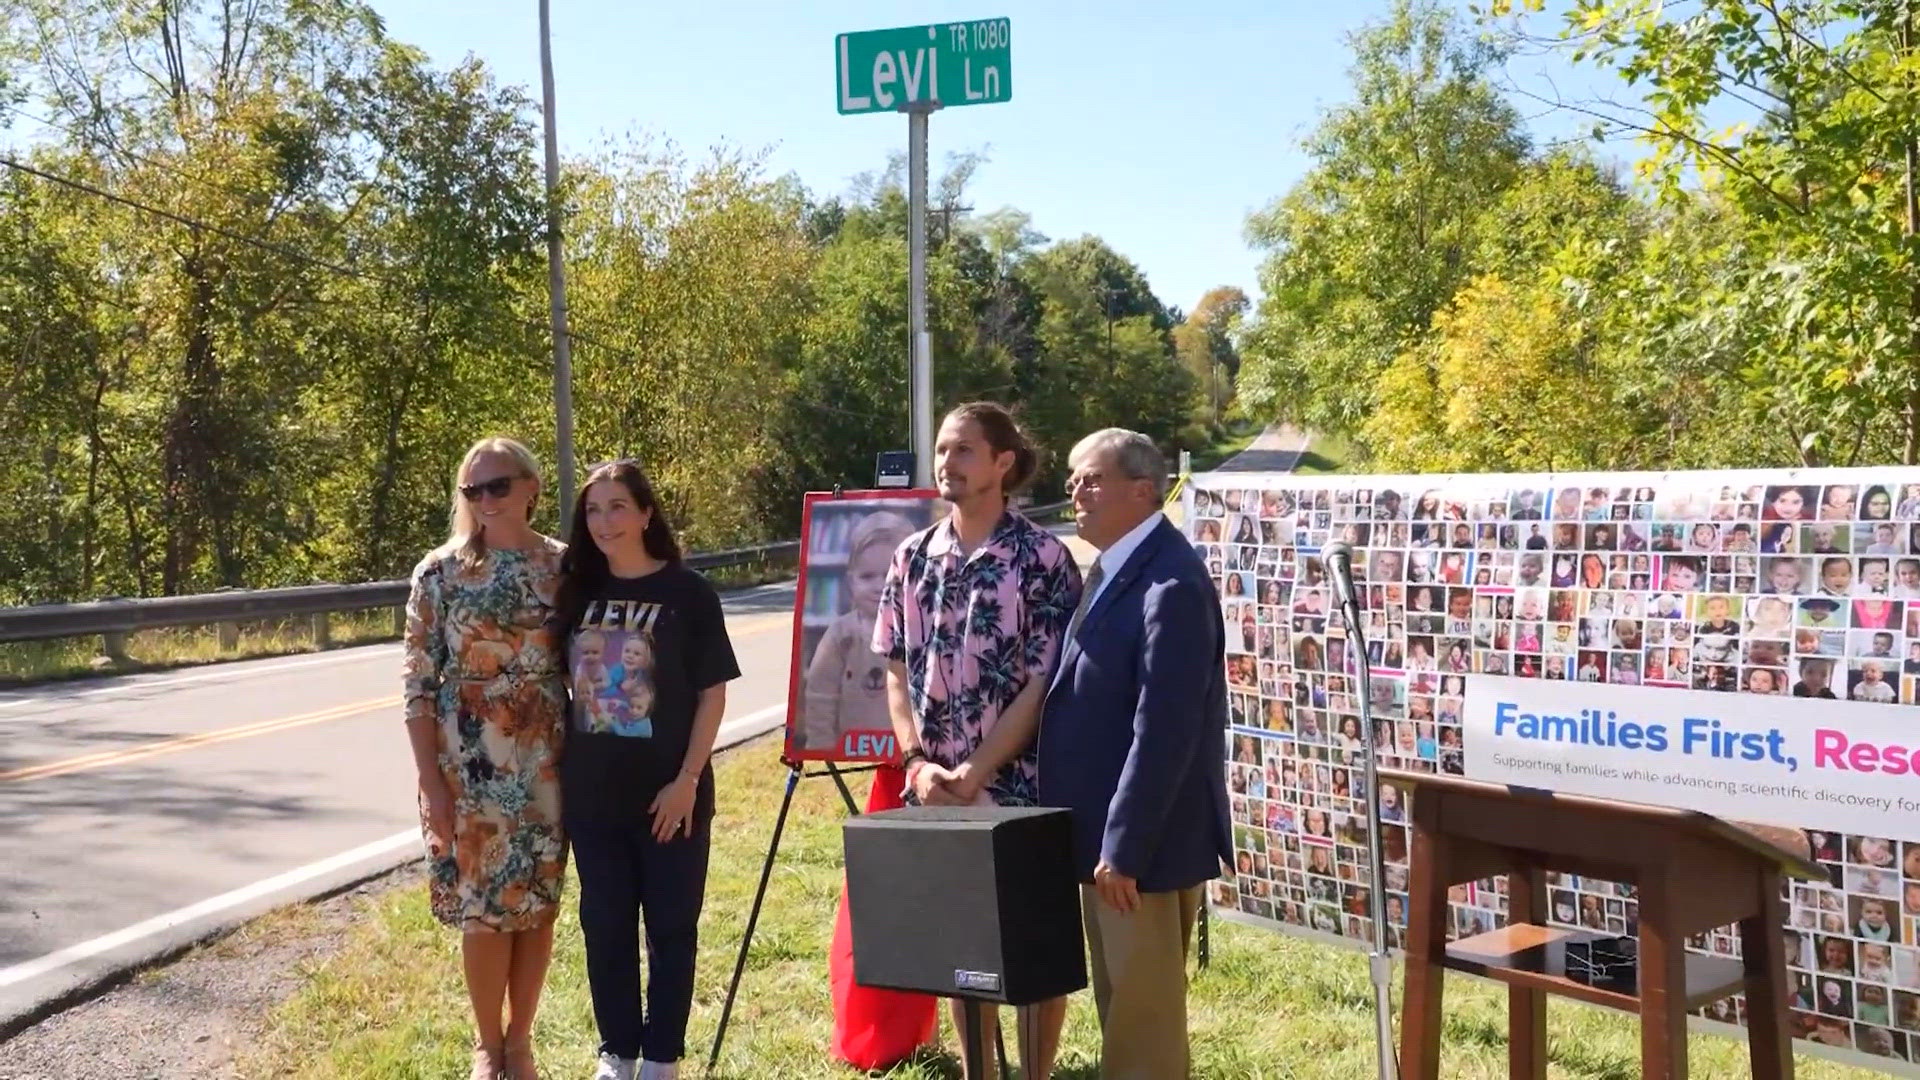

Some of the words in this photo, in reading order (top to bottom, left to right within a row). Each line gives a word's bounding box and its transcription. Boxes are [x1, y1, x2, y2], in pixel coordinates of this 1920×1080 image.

[949, 23, 967, 52] TR
[973, 20, 1008, 51] 1080
[840, 26, 939, 110] Levi
[964, 57, 1000, 100] Ln
[579, 599, 663, 633] LEVI
[844, 733, 895, 758] LEVI
[1494, 702, 1668, 752] Families
[1682, 718, 1798, 772] First,
[1493, 753, 1562, 774] Supporting
[1566, 762, 1618, 779] families
[1622, 769, 1660, 783] while
[1663, 772, 1736, 795] advancing
[1741, 782, 1808, 800] scientific
[1814, 789, 1892, 812] discovery
